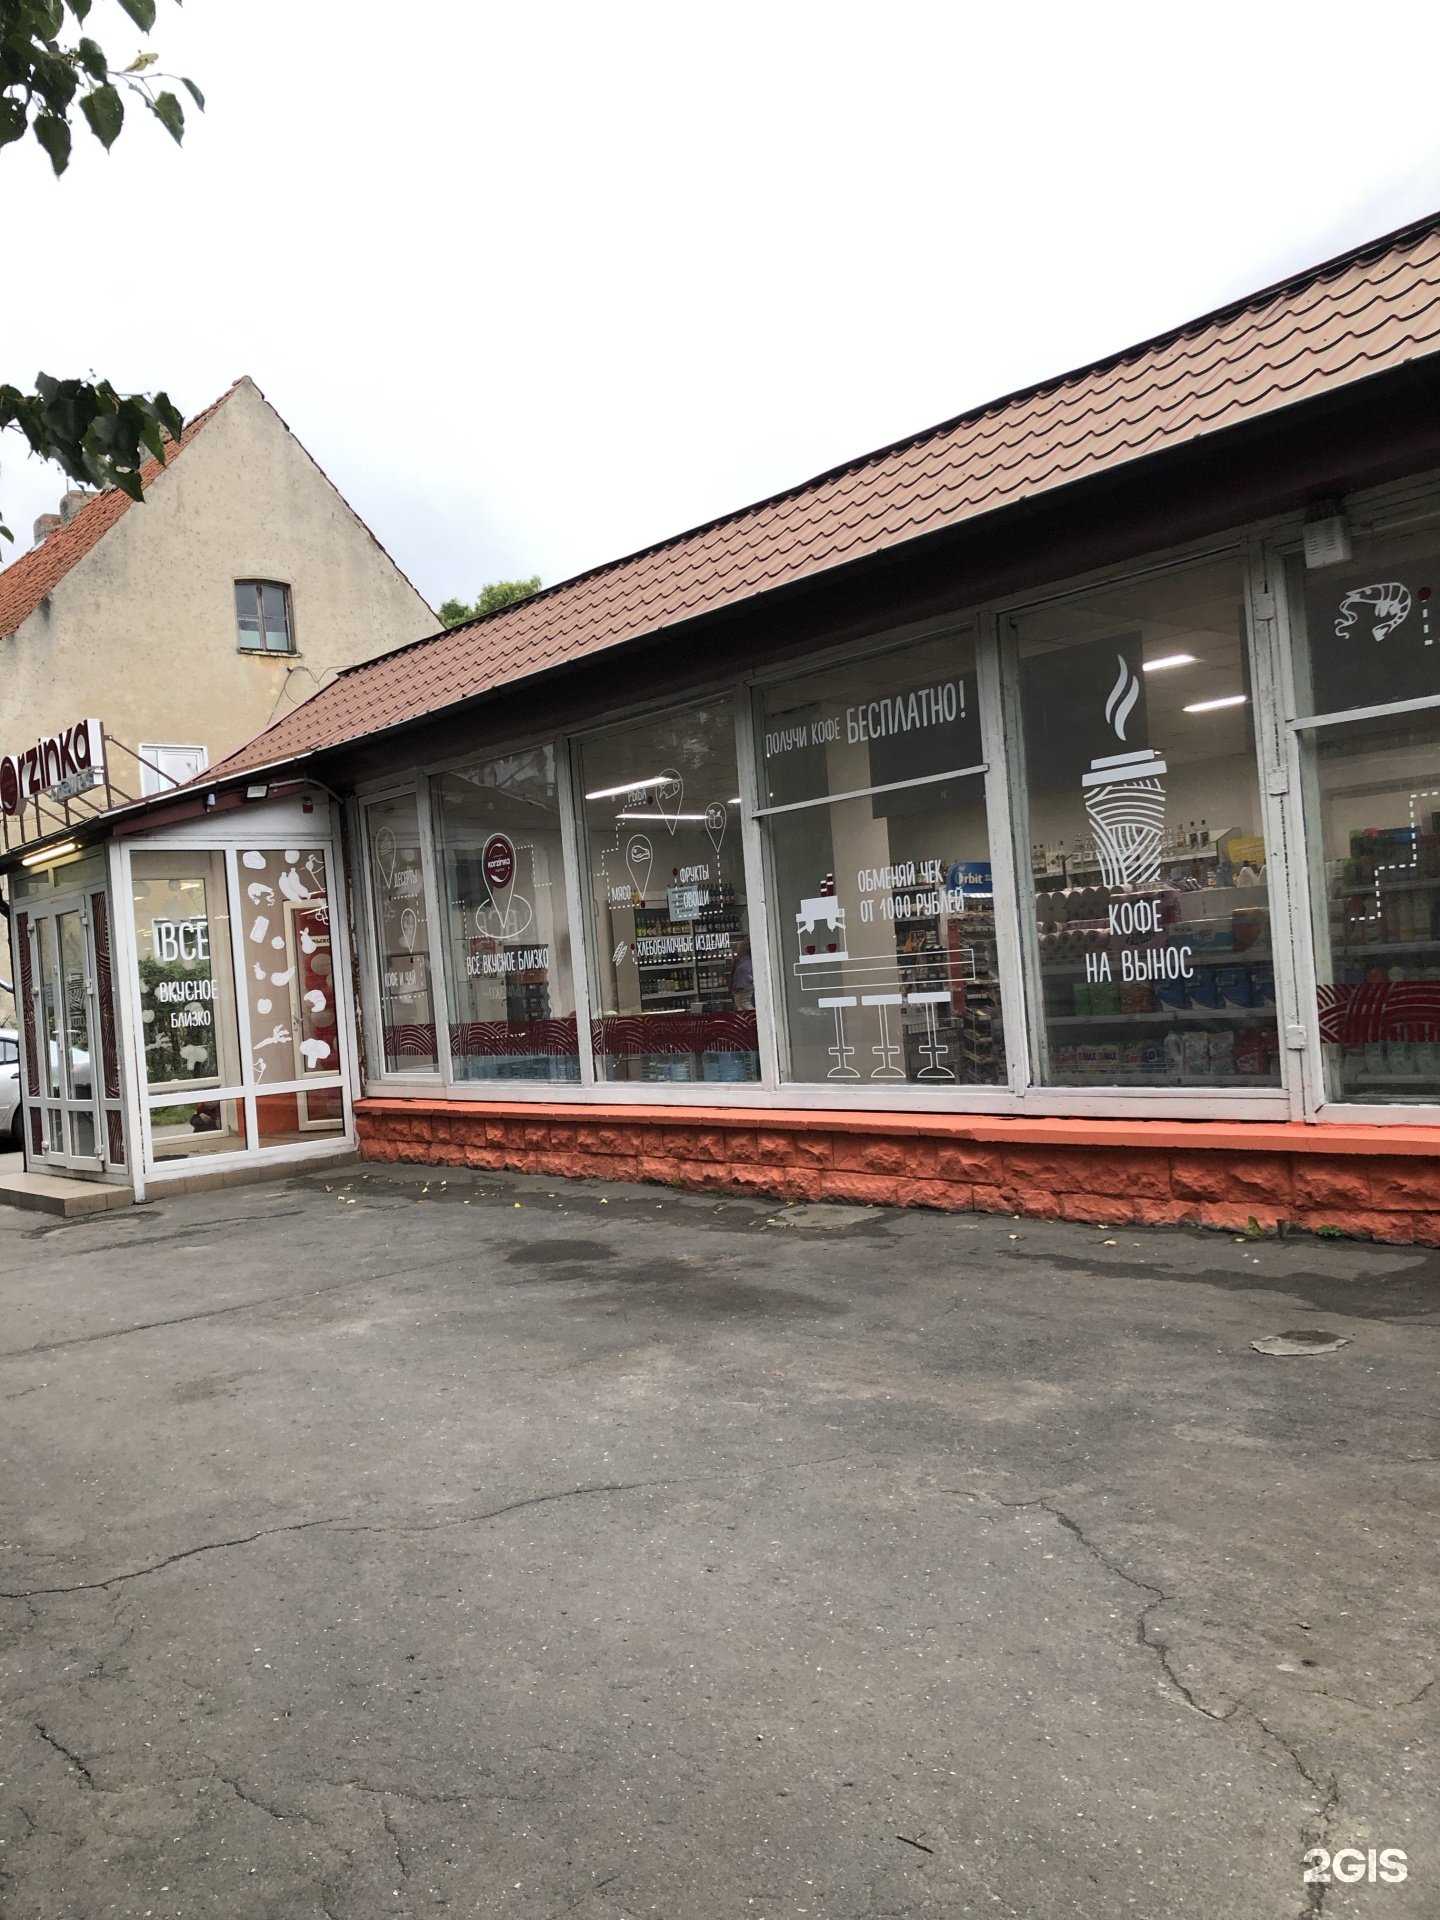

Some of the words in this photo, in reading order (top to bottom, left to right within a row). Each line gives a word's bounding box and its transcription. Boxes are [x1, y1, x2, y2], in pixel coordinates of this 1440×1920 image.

[765, 726, 808, 755] ПОЛУЧИ
[811, 717, 841, 745] КОФЕ
[846, 680, 966, 744] БЕСПЛАТНО!
[679, 864, 710, 883] ФРУКТЫ
[857, 861, 916, 893] ОБМЕНЯЙ
[920, 859, 944, 884] ЧЕК
[611, 885, 631, 901] МЯСО
[683, 889, 710, 908] ОВОЩИ
[860, 899, 875, 922] ОТ
[879, 895, 911, 920] 1000
[915, 887, 965, 917] РУБЛЕЙ
[1108, 899, 1164, 936] КОФЕ
[636, 935, 694, 957] ХЛЕБОБУЛОЧНЫЕ
[695, 932, 730, 951] ИЗДЕЛИЯ
[466, 951, 481, 976] ВСЁ
[482, 951, 515, 975] ВКУСНОЕ
[518, 947, 549, 971] БЛИЗКО
[1085, 951, 1112, 983] НА
[1121, 945, 1194, 982] ВЫНОС
[160, 979, 220, 1003] ВКУСНОЕ
[171, 1009, 211, 1028] БЛИЗКО
